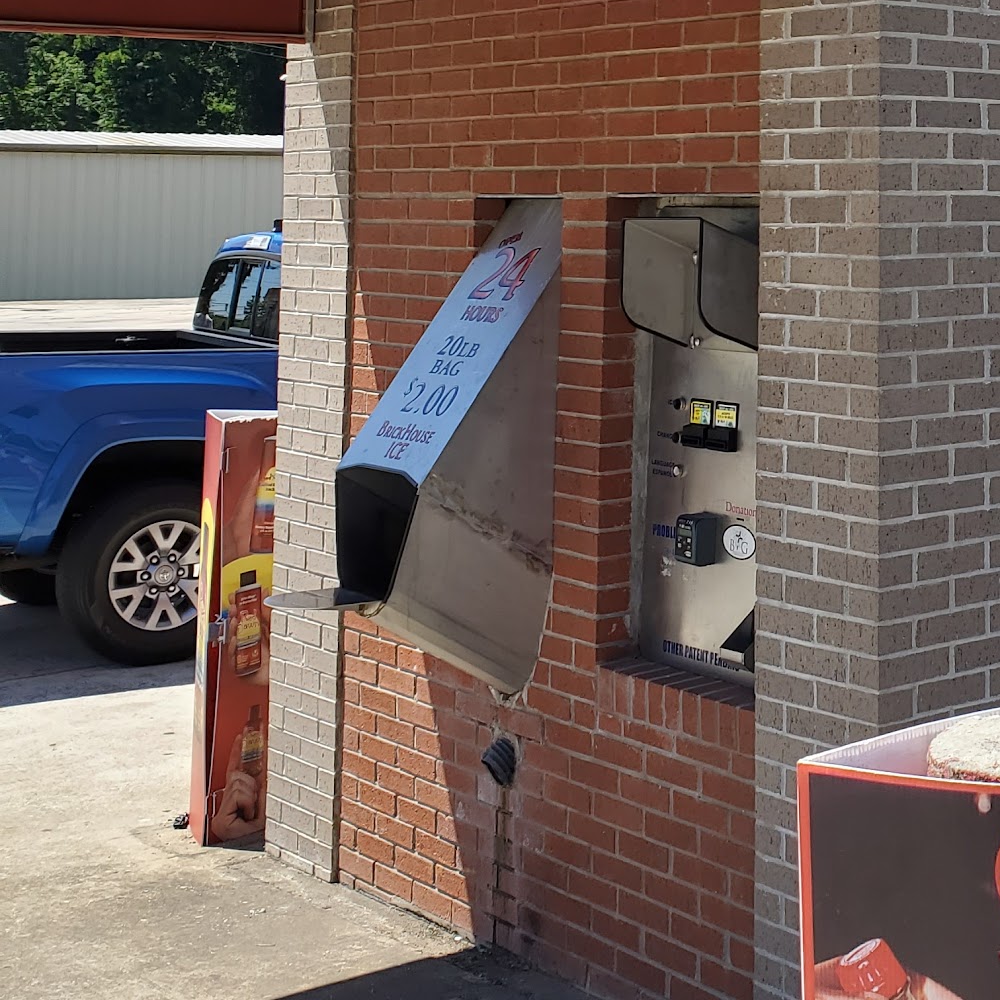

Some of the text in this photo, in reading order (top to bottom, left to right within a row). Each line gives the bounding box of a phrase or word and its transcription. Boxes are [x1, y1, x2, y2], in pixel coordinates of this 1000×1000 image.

[468, 246, 541, 301] 24
[460, 305, 504, 323] HOURS
[429, 359, 464, 376] BAG
[400, 377, 459, 417] $2.00
[384, 441, 409, 460] ICE
[662, 639, 683, 657] OTHER
[684, 645, 709, 663] PATENT
